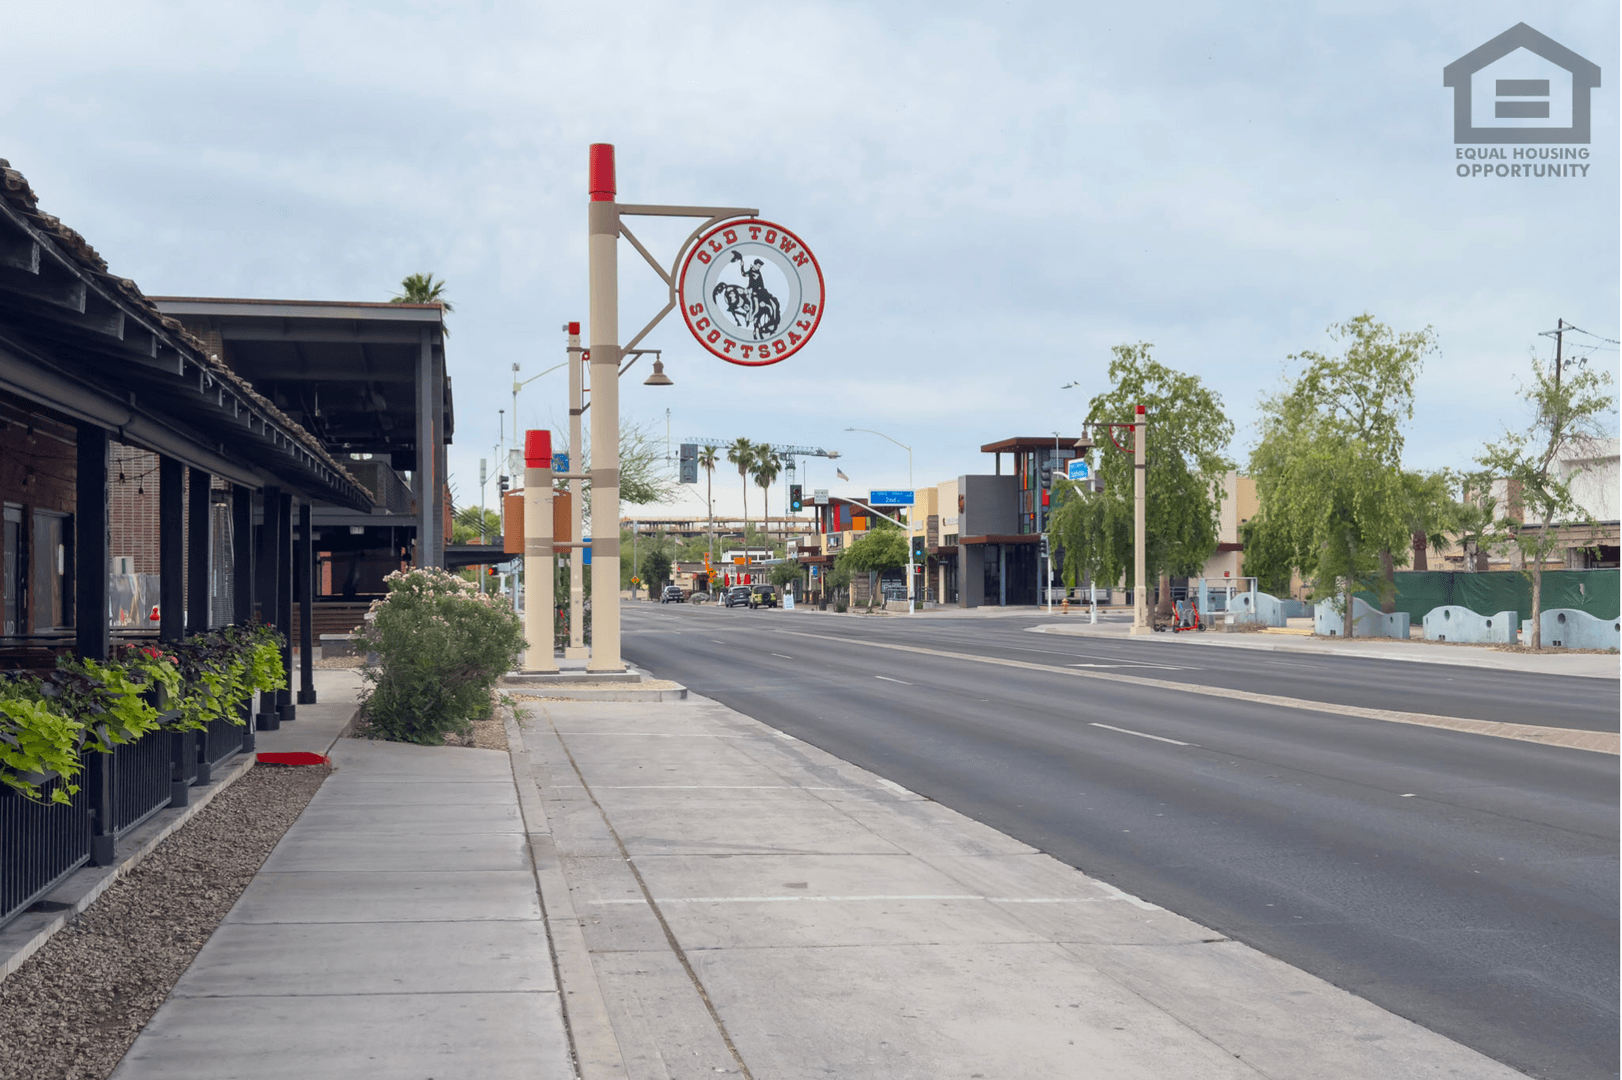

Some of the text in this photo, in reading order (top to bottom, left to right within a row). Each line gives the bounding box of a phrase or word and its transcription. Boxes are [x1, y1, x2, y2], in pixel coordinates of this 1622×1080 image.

[697, 226, 809, 267] OLD TOWN
[689, 303, 817, 359] SCOTTSDALE
